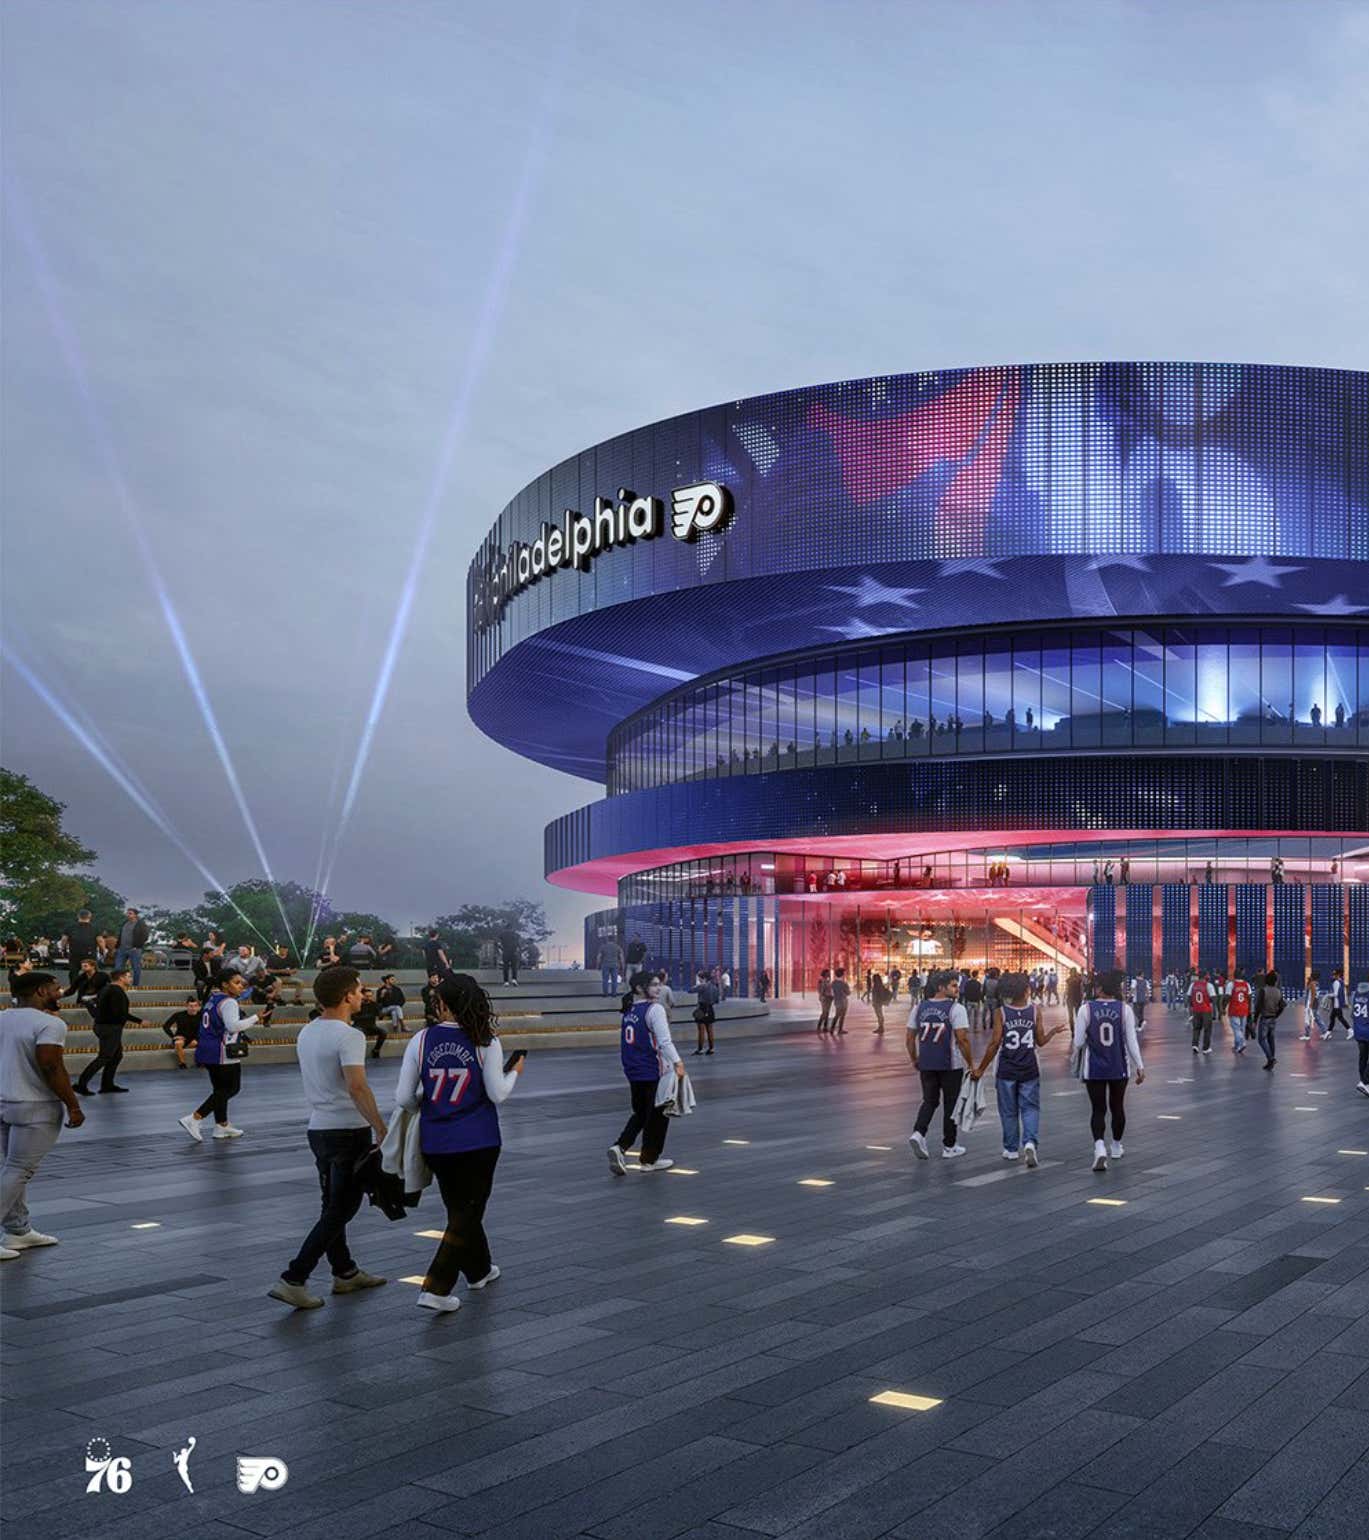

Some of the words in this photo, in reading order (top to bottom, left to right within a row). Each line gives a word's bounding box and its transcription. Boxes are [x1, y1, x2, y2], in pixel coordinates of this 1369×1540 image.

[1353, 1003, 1369, 1018] 34
[920, 1022, 945, 1043] 77
[1005, 1029, 1034, 1050] 34
[1100, 1022, 1114, 1047] 0
[428, 1067, 471, 1106] 77
